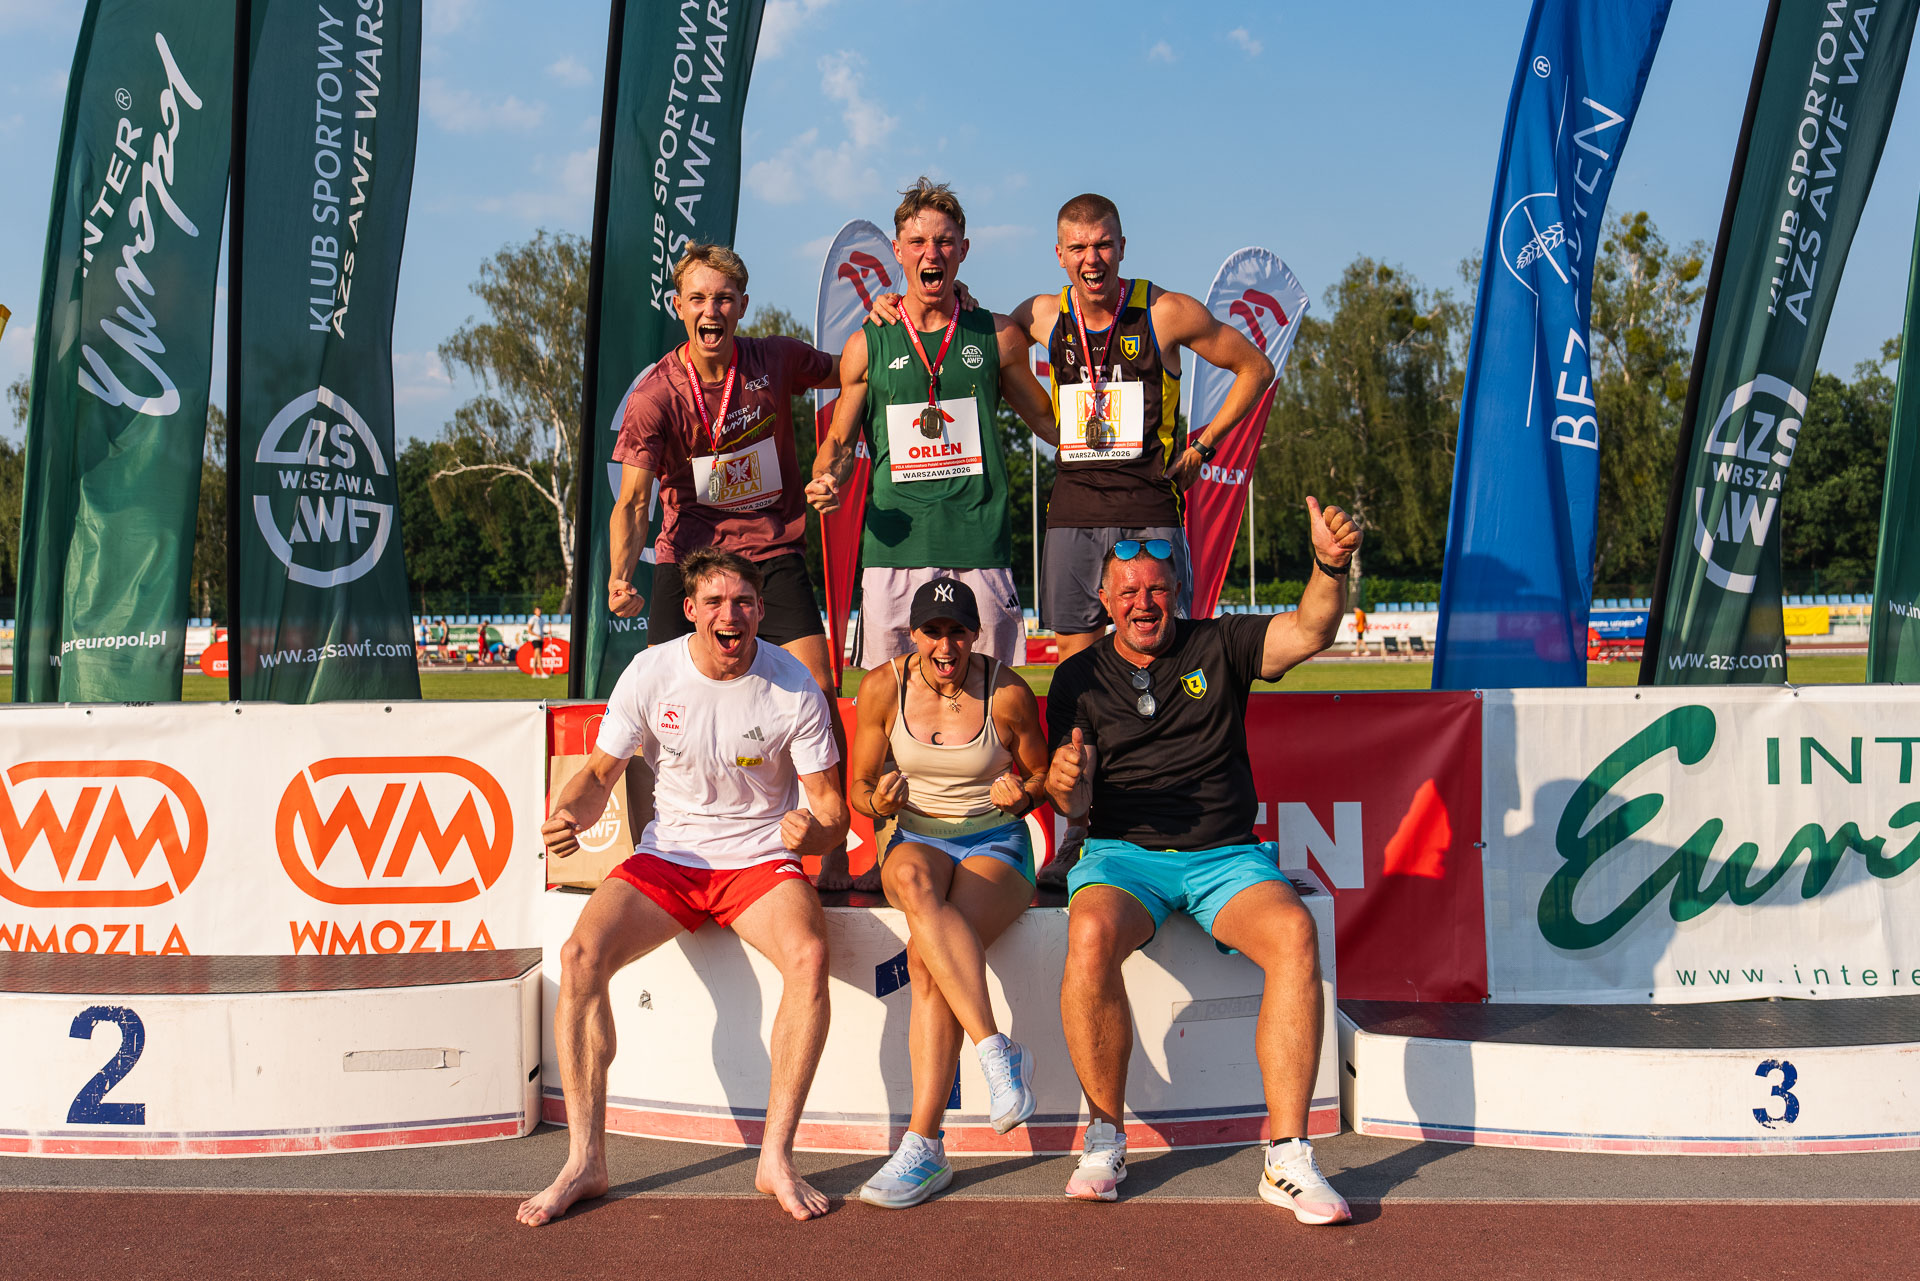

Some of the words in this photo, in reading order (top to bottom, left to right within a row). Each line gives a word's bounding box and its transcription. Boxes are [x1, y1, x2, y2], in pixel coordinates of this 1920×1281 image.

[313, 4, 344, 227] SPORTOWY
[674, 113, 716, 227] AWF
[697, 0, 729, 103] WAR
[1784, 226, 1821, 326] AZS
[1808, 96, 1849, 221] AWF
[1837, 0, 1878, 85] WA
[332, 249, 355, 339] AZS
[349, 130, 373, 243] AWF
[651, 212, 666, 311] KLUB
[1767, 210, 1800, 316] KLUB
[310, 235, 341, 333] KLUB
[727, 407, 749, 420] INTER
[903, 469, 951, 479] WARSZAWA
[952, 466, 971, 474] 2026
[909, 443, 962, 459] ORLEN
[1200, 463, 1247, 485] ORLEN
[721, 480, 760, 500] PZLA
[1191, 678, 1199, 689] Z
[661, 722, 680, 730] ORLEN
[290, 918, 497, 956] WMOZLA
[66, 1005, 146, 1126] 2
[1752, 1059, 1800, 1129] 3
